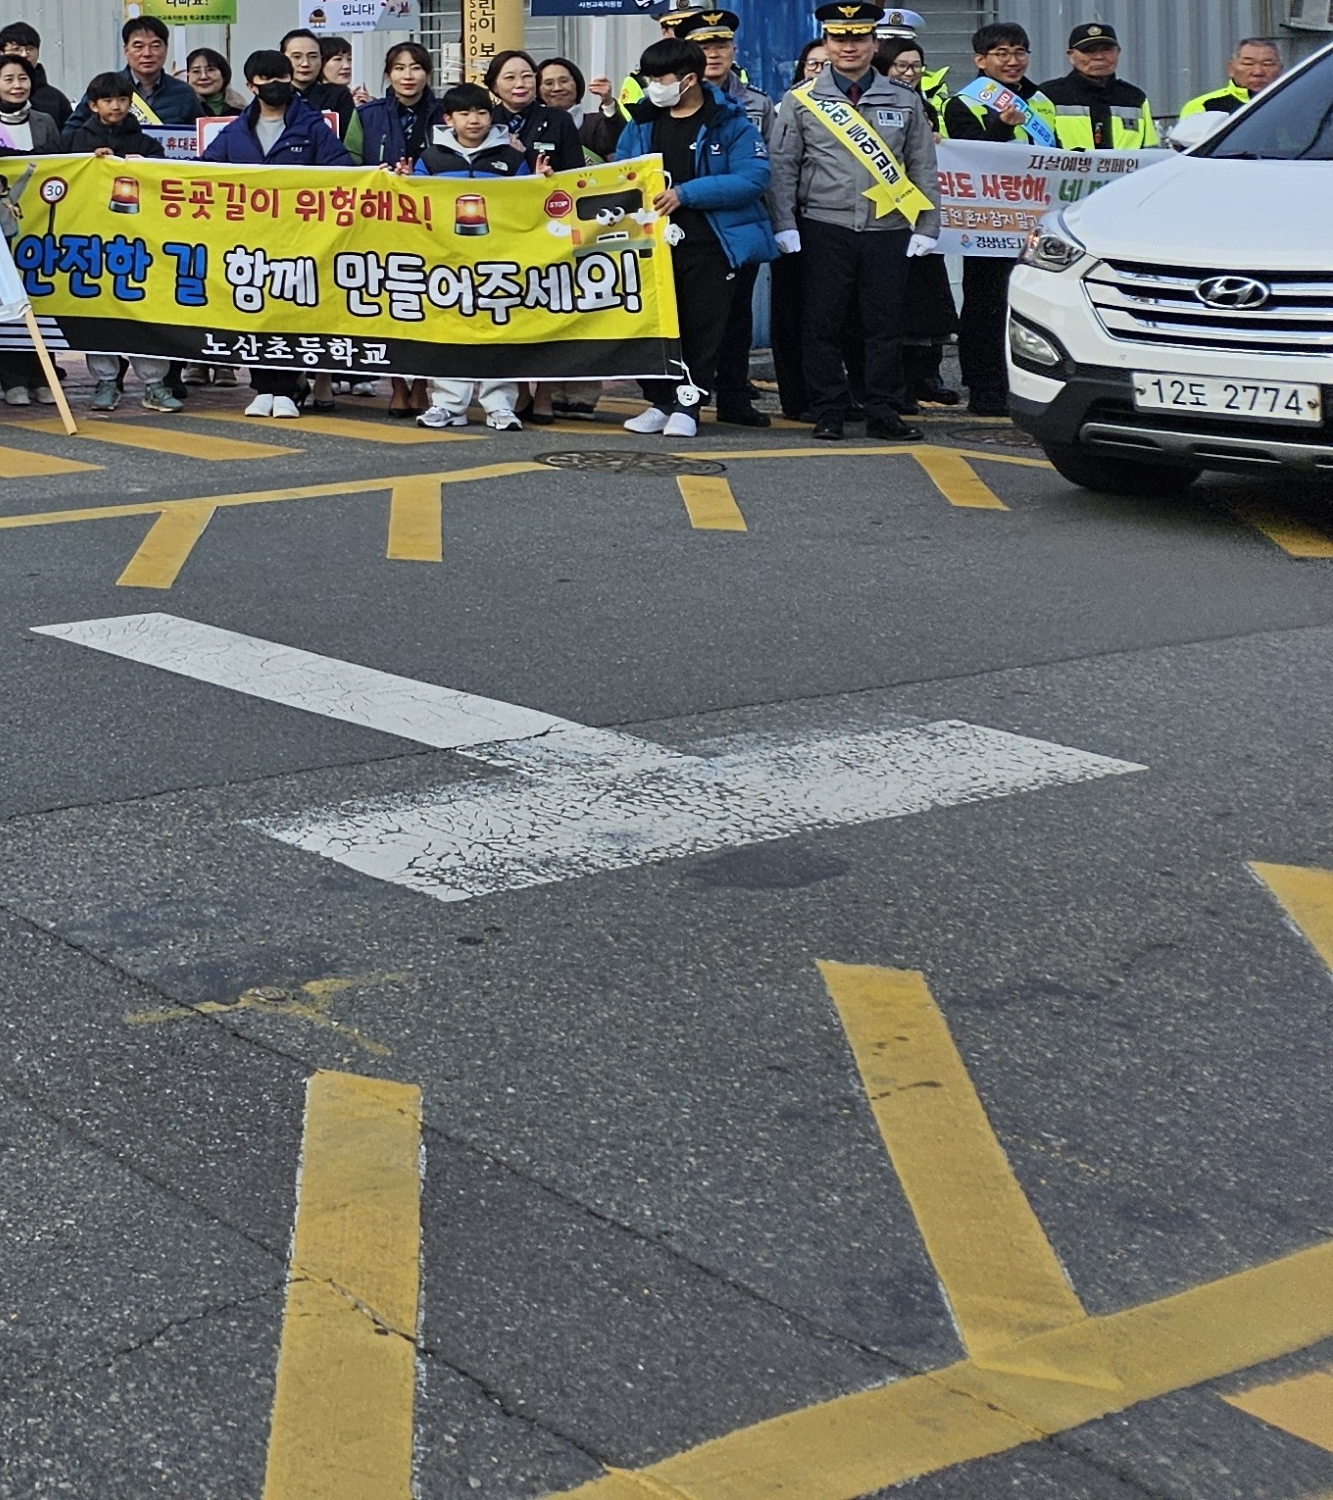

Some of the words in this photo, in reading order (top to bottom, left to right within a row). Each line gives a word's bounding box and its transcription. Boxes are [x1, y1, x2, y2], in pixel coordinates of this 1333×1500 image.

[342, 3, 375, 16] 입니다!
[1027, 154, 1093, 173] 자살예방
[1096, 157, 1139, 174] 캠페인
[45, 184, 64, 197] 30
[981, 172, 1052, 206] 사랑해,
[1058, 178, 1083, 203] 네
[159, 179, 280, 222] 등굣길이
[294, 185, 433, 231] 위험해요!
[548, 200, 569, 208] STOP
[964, 208, 988, 228] 혼자
[989, 210, 1015, 228] 참지
[15, 233, 153, 302] 안전한
[162, 241, 209, 307] 길
[223, 244, 319, 313] 함께
[333, 248, 643, 326] 만들어주세요!
[200, 331, 391, 368] 노산초등학교
[1151, 378, 1209, 407] 12도
[1223, 384, 1303, 416] 2774
